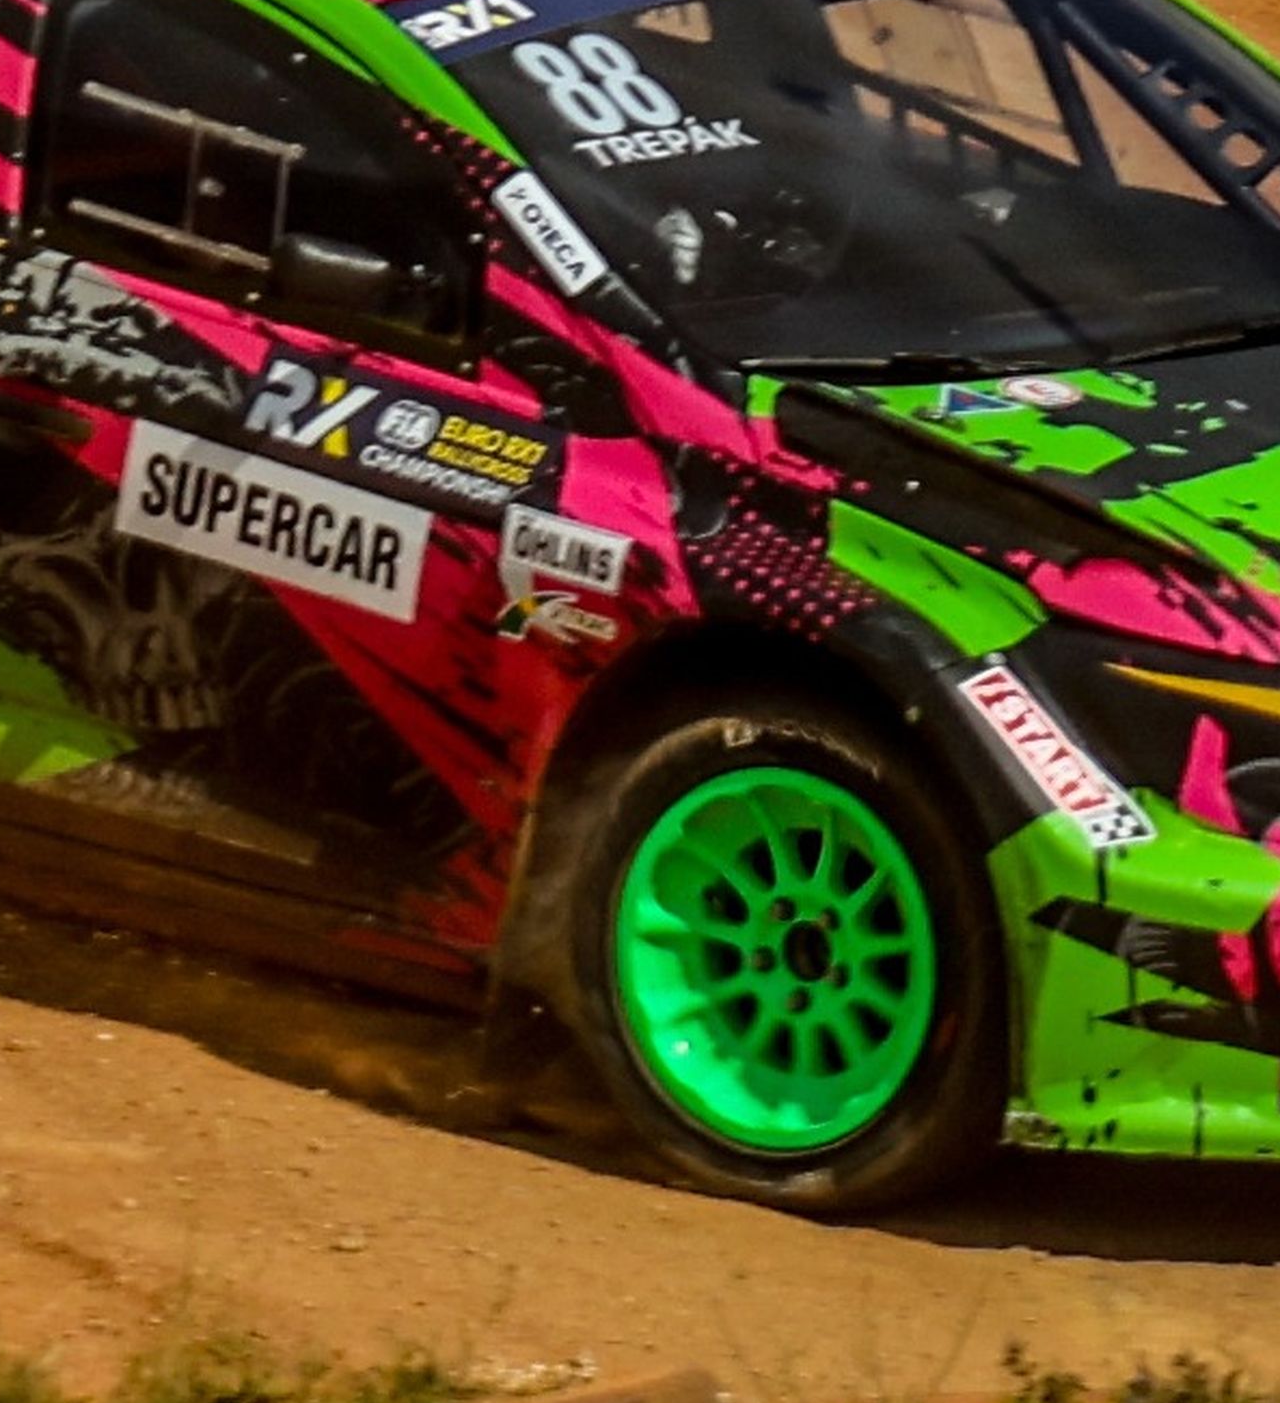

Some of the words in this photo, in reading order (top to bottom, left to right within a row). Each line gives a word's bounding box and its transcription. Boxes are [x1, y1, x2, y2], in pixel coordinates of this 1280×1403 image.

[513, 33, 681, 135] 88
[573, 116, 761, 167] TREPÁK
[243, 359, 381, 459] RX
[140, 453, 402, 591] SUPERCAR
